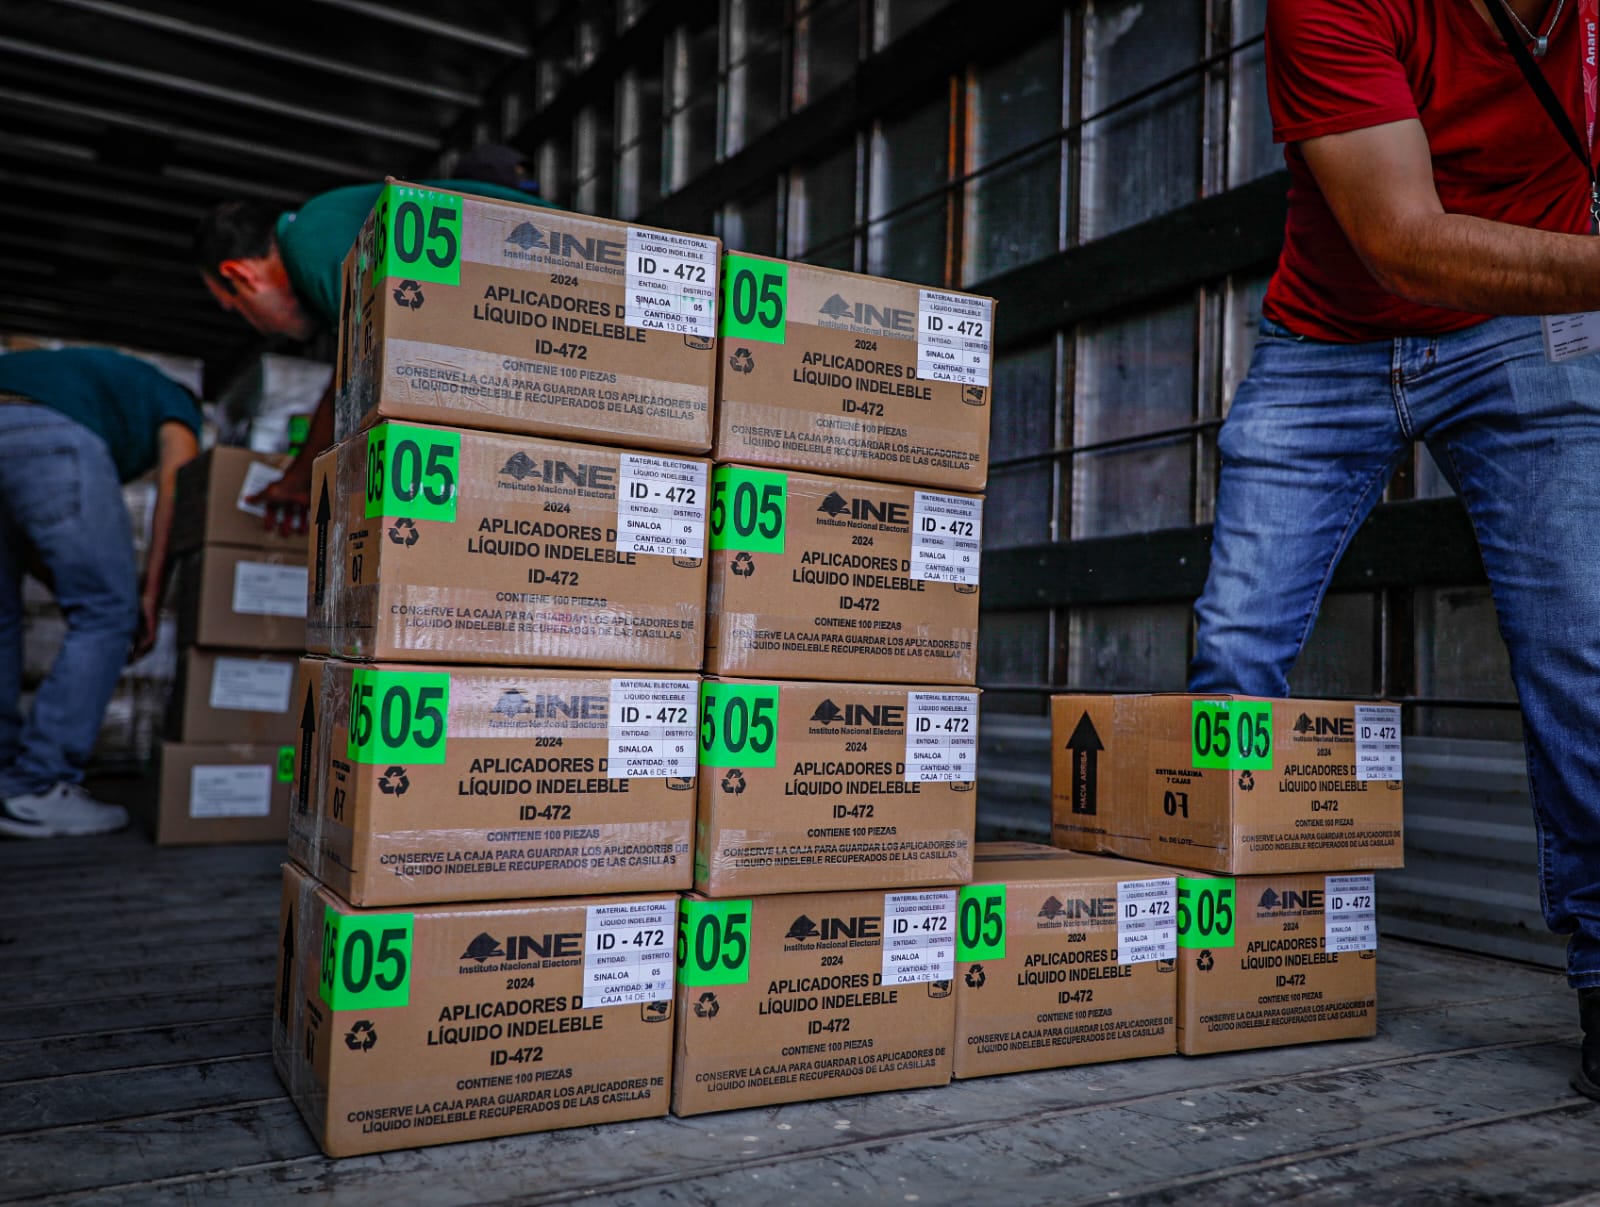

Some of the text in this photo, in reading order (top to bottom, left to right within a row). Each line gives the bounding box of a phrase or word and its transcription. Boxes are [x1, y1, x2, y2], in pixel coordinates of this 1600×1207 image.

[1586, 22, 1596, 66] Anara
[394, 201, 457, 269] 05
[548, 232, 626, 267] INE
[637, 256, 657, 275] ID
[674, 263, 706, 283] 472
[550, 273, 578, 287] 2024
[484, 285, 610, 317] APLICADORES
[733, 269, 783, 328] 05
[473, 303, 646, 343] LÍQUIDO INDELEBLE
[854, 302, 915, 332] INE
[927, 315, 983, 338] ID 472
[535, 338, 587, 360] ID-472
[854, 339, 877, 351] 2024
[801, 351, 903, 378] APLICADORES
[793, 367, 932, 401] LÍQUIDO INDELEBLE
[842, 398, 884, 417] ID-472
[391, 440, 454, 506] 05
[629, 457, 699, 471] MATERIAL ELECTORAL
[542, 460, 617, 490] INE
[661, 473, 694, 482] INDELEBLE
[630, 482, 649, 499] ID
[665, 486, 696, 505] 472
[543, 501, 571, 514] 2024
[734, 482, 782, 538] 05
[851, 498, 910, 525] INE
[478, 517, 602, 542] APLICADORES
[626, 520, 662, 530] SINALOA
[683, 525, 692, 533] 05
[921, 516, 973, 537] ID 472
[467, 535, 636, 565] LÍQUIDO INDELEBLE
[633, 543, 655, 553] CAJA
[657, 546, 665, 554] 12
[666, 546, 677, 554] DE
[675, 538, 687, 546] 100
[852, 535, 874, 546] 2024
[800, 550, 898, 571] APLICADORES
[528, 568, 579, 586] ID-472
[792, 567, 925, 592] LÍQUIDO INDELEBLE
[840, 595, 880, 611] ID-472
[380, 685, 444, 748] 05
[534, 695, 609, 720] INE
[621, 706, 640, 723] ID
[656, 707, 688, 724] 472
[844, 704, 905, 727] INE
[723, 696, 773, 753] 05
[916, 717, 969, 733] ID 472
[1194, 711, 1231, 757] 05
[1315, 717, 1355, 736] INE
[1361, 726, 1396, 740] ID 472
[535, 736, 563, 748] 2024
[1237, 712, 1270, 758] 05
[845, 742, 868, 752] 2024
[469, 758, 594, 773] APLICADORES
[793, 761, 892, 776] APLICADORES
[1284, 764, 1349, 776] APLICADORES
[458, 777, 629, 796] LÍQUIDO INDELEBLE
[784, 779, 920, 797] LÍQUIDO INDELEBLE
[1279, 778, 1368, 793] LÍQUIDO INDELEBLE
[520, 804, 571, 820] ID-472
[833, 804, 874, 818] ID-472
[1311, 800, 1338, 811] ID-472
[486, 828, 600, 842] CONTIENE 100 PIEZAS
[1066, 898, 1117, 920] INE
[1125, 900, 1170, 918] ID 472
[1281, 890, 1324, 910] INE
[1332, 895, 1370, 910] ID 472
[960, 896, 1002, 949] 05
[1198, 889, 1232, 936] 05
[820, 917, 882, 941] INE
[893, 916, 947, 934] ID 472
[505, 933, 582, 961] INE
[596, 933, 616, 951] ID
[633, 929, 664, 947] 472
[695, 913, 747, 971] 05
[1067, 933, 1086, 943] 2024
[1246, 937, 1318, 953] APLICADORES
[342, 928, 407, 993] 05
[458, 957, 582, 974] Instituto Nacional Electoral
[821, 956, 844, 967] 2024
[1024, 949, 1108, 967] APLICADORES
[1241, 952, 1338, 970] LÍQUIDO INDELEBLE
[506, 977, 535, 990] 2024
[767, 973, 869, 995] APLICADORES
[1017, 965, 1132, 986] LÍQUIDO INDELEBLE
[1276, 973, 1306, 987] ID-472
[758, 990, 898, 1016] LÍQUIDO INDELEBLE
[1058, 989, 1093, 1004] ID-472
[438, 996, 567, 1022] APLICADORES
[427, 1014, 603, 1046] LÍQUIDO INDELEBLE
[808, 1018, 850, 1035] ID-472
[490, 1046, 543, 1066] ID-472
[456, 1068, 572, 1090] CONTIENE 100 PIEZAS
[347, 1076, 664, 1123] CONSERVE LA CAJA PARA GUARDAR LOS APLICADORES DE
[362, 1089, 651, 1134] LÍQUIDO INDELEBLE RECUPERADOS DE LAS CASILLAS
